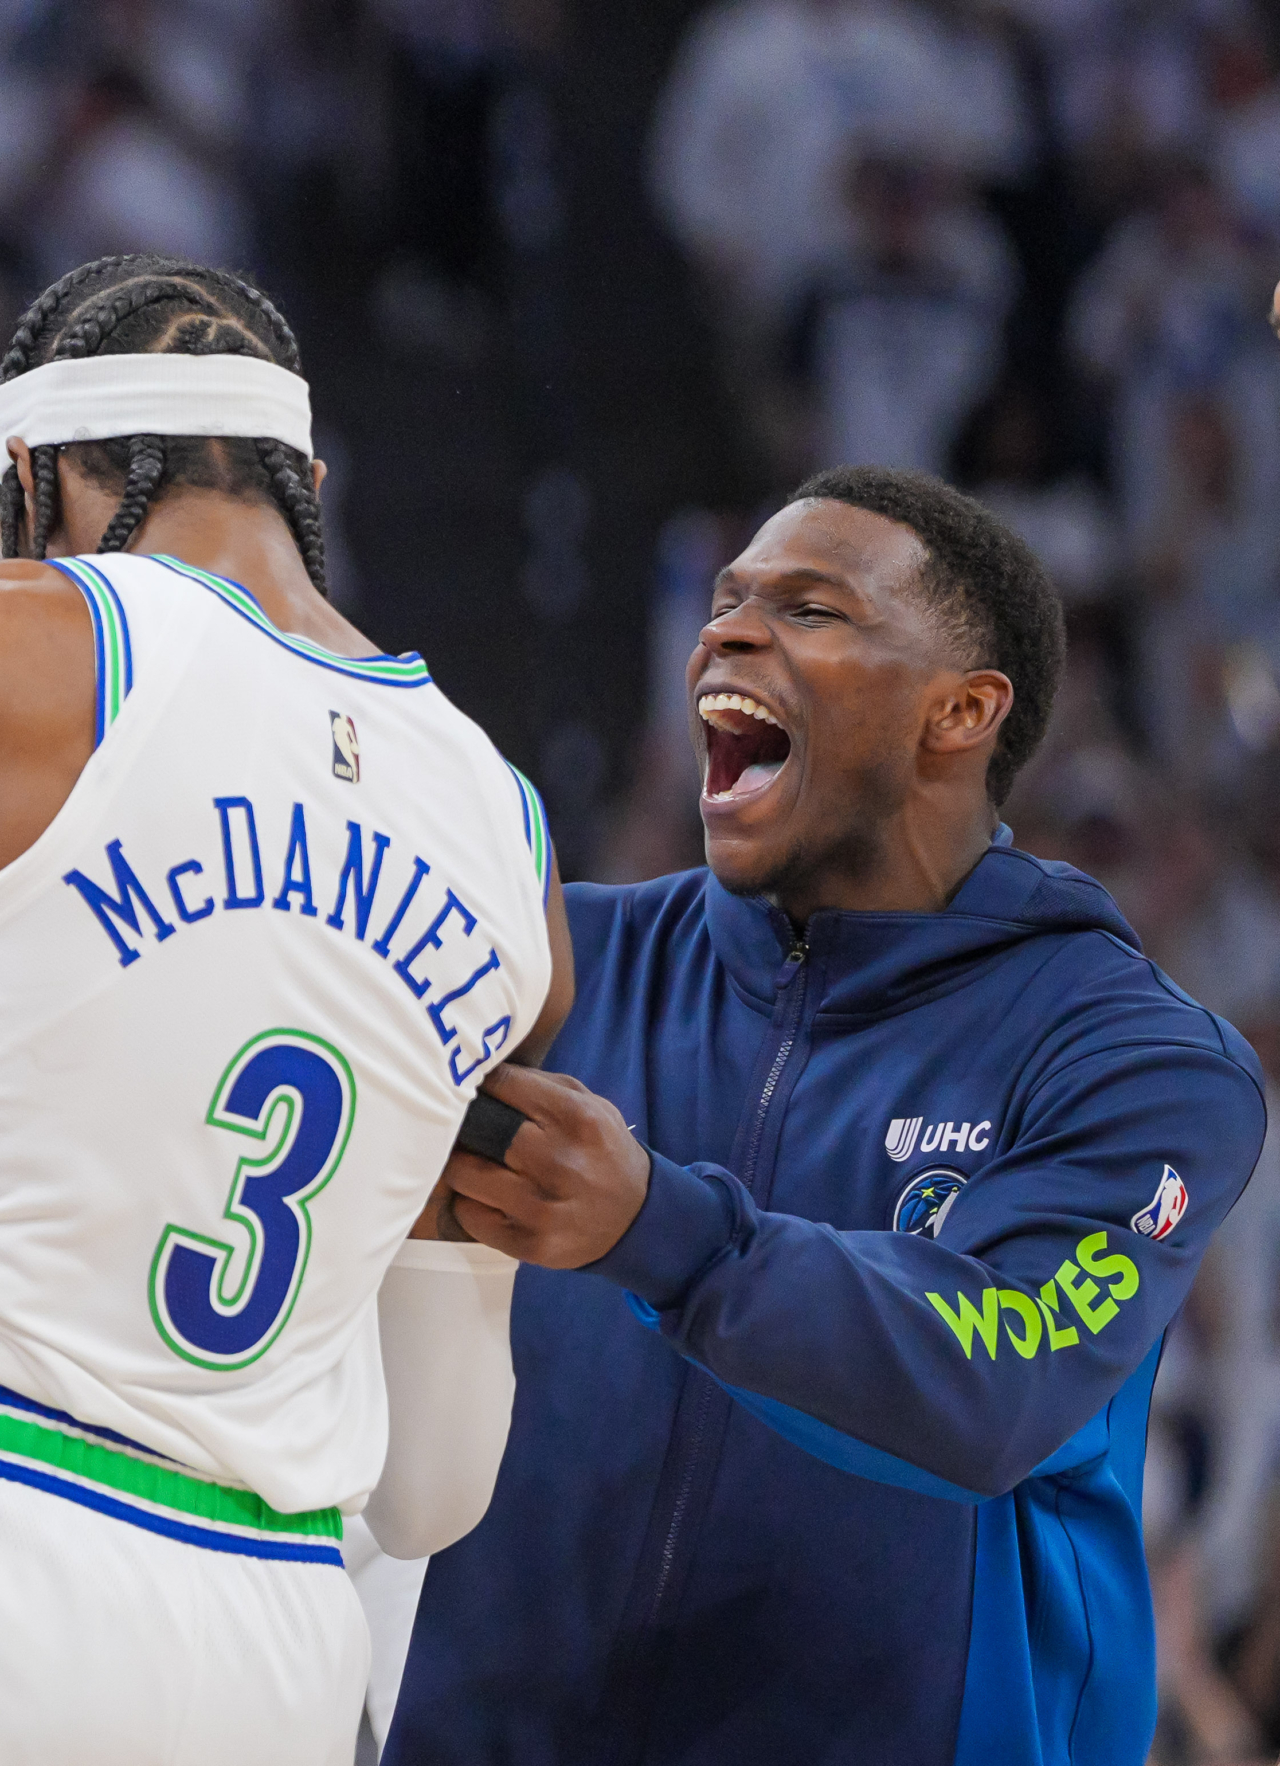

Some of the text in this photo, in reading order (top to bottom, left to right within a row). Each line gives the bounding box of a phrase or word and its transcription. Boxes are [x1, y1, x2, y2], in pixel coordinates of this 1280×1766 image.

[62, 796, 511, 1086] McDANIELS
[148, 1027, 356, 1371] 3
[920, 1120, 992, 1153] UHC
